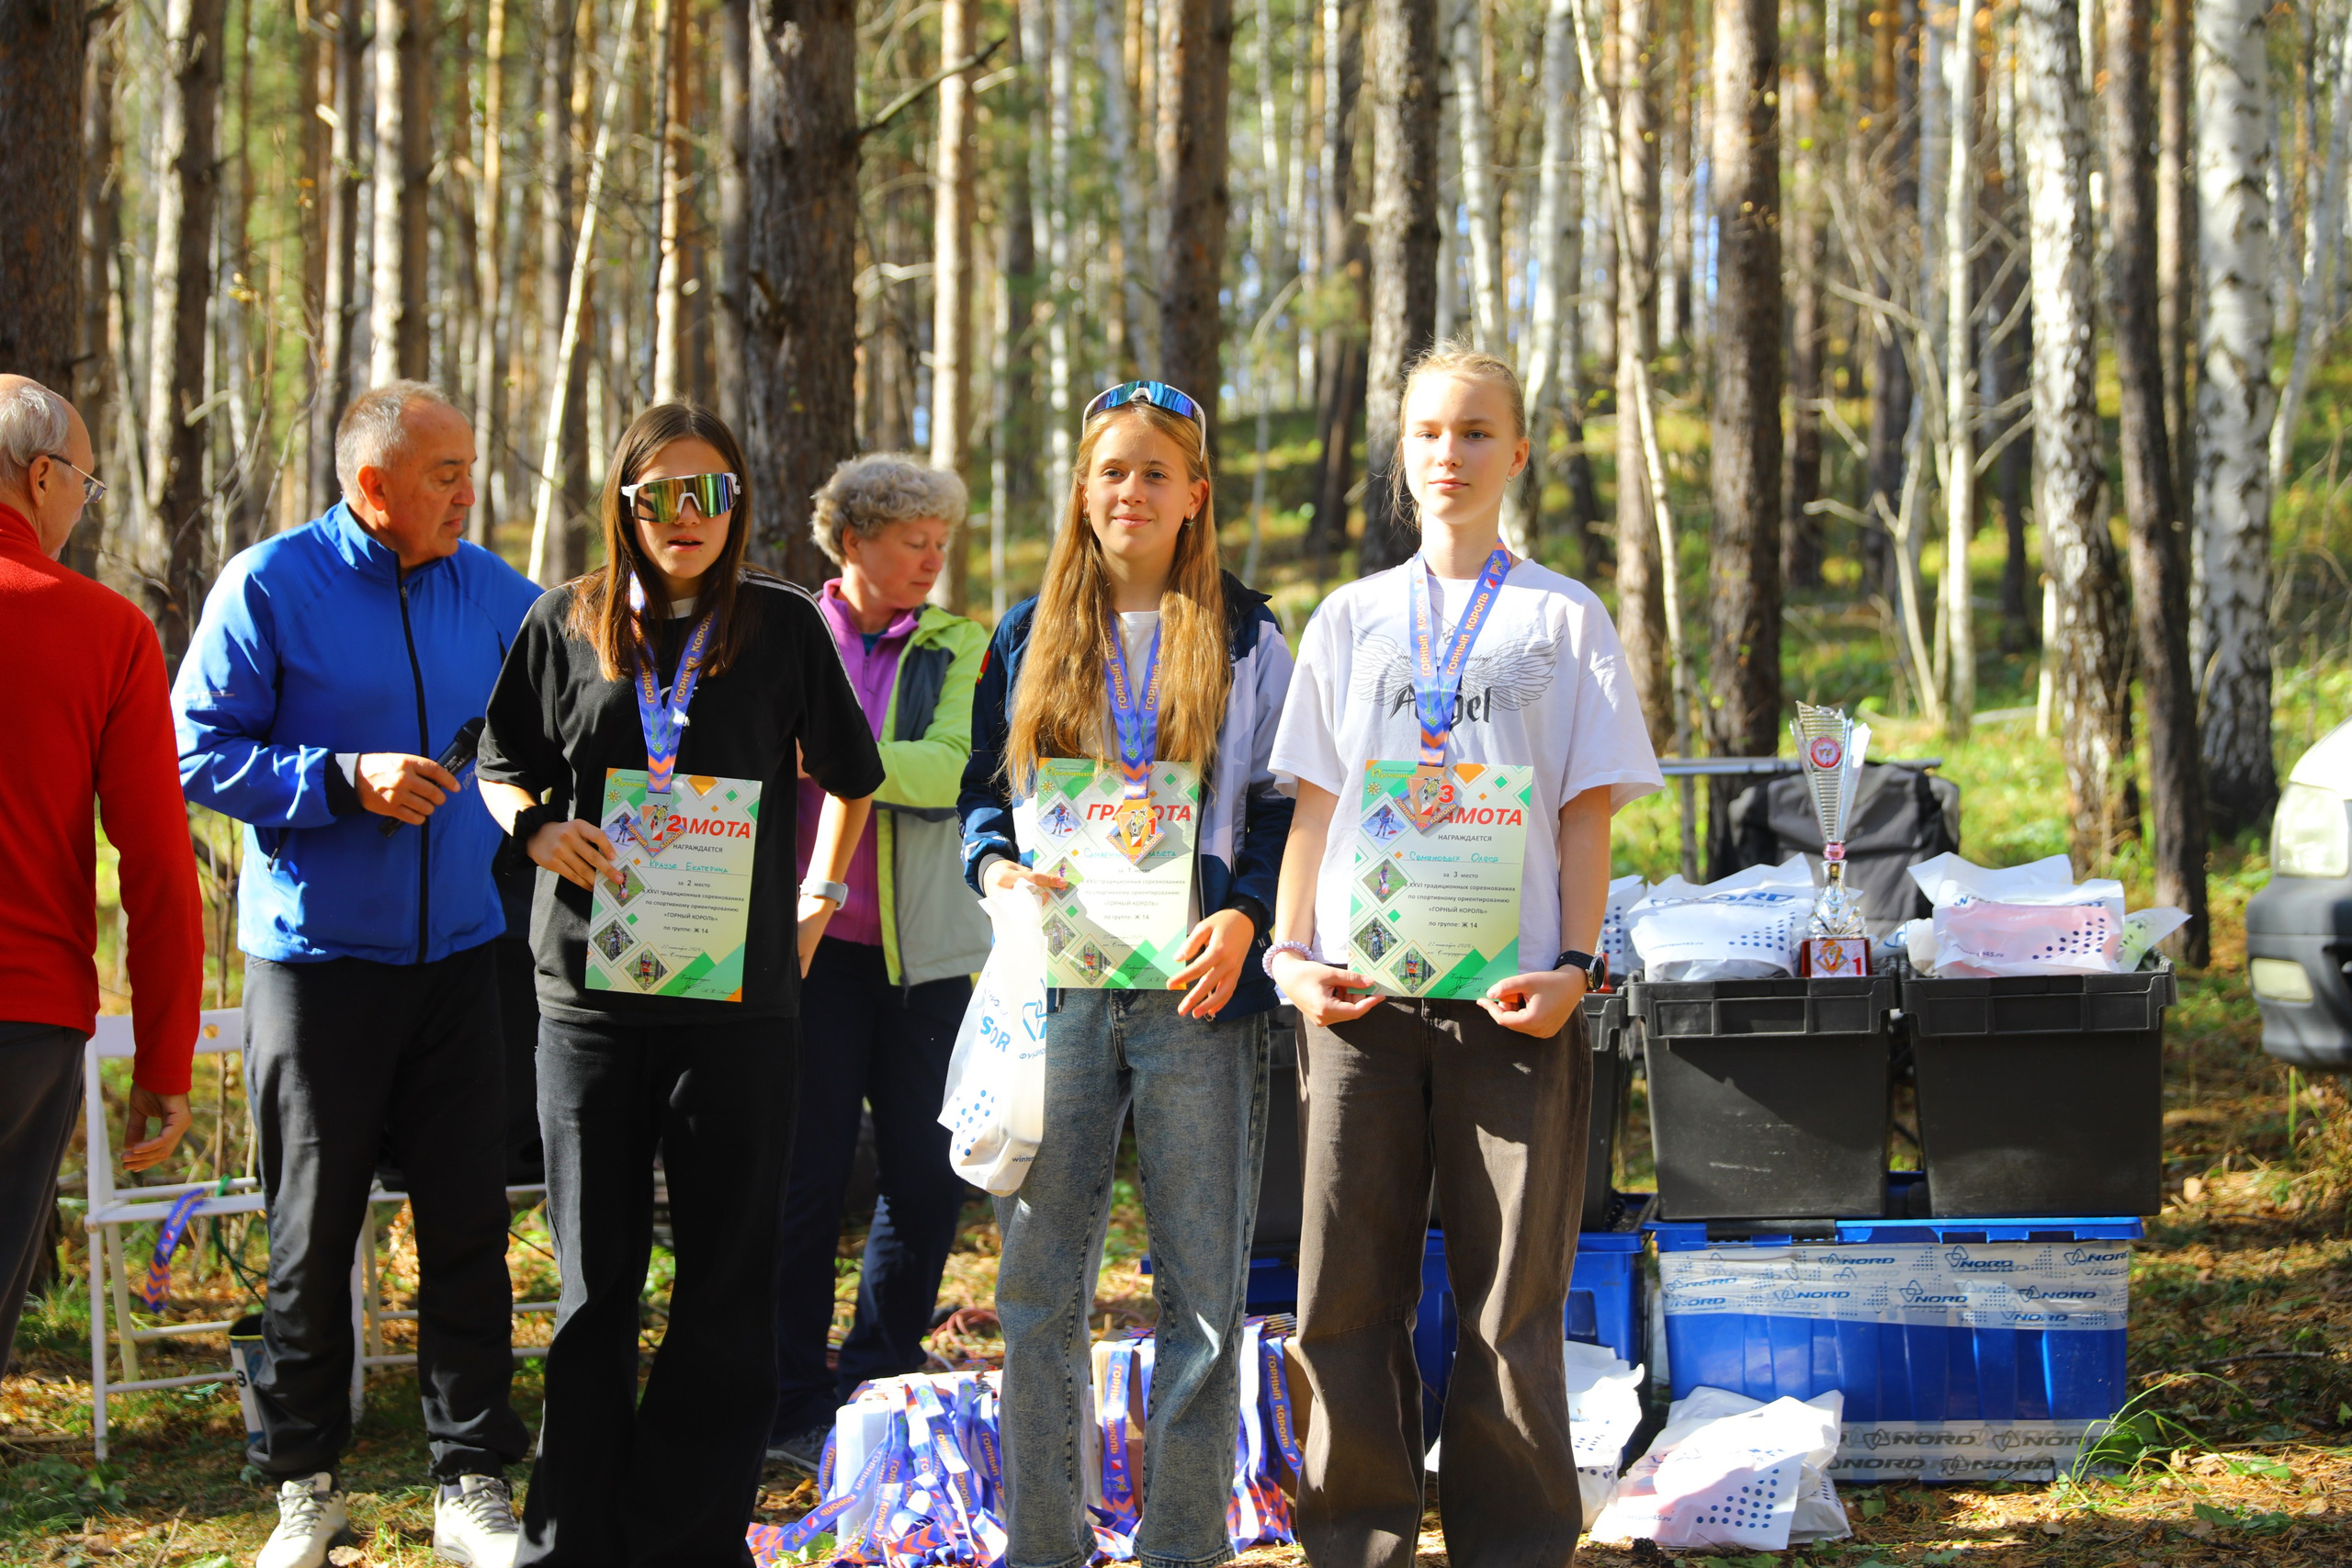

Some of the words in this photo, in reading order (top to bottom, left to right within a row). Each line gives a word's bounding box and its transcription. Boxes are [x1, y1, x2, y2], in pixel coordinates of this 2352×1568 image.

[1446, 634, 1470, 675] ГОРНЫЙ
[1464, 592, 1489, 630] КОРОЛЬ
[1419, 635, 1430, 676] ГОРНЫЙ
[1113, 664, 1128, 709] ГОРНЫЙ
[1389, 682, 1493, 732] Agel
[1438, 784, 1454, 804] 3
[1086, 804, 1191, 821] ГРОТА
[1430, 804, 1456, 824] КОРОЛЬ
[1439, 807, 1521, 826] АМОТА
[666, 814, 683, 833] 2
[683, 817, 751, 839] МОТА
[1148, 817, 1157, 835] 1
[627, 823, 649, 848] ГОРНЫЙ
[660, 829, 684, 850] КОРОЛЬ
[673, 843, 723, 853] НАГРАЖДАЕТСЯ
[660, 890, 701, 898] традиционных
[702, 894, 745, 902] соревнованиях
[1424, 883, 1468, 891] традиционных
[653, 901, 690, 909] спортивному
[691, 904, 739, 912] ориентированию
[1853, 957, 1861, 975] 1
[1960, 1259, 2012, 1268] NORD
[2087, 1252, 2129, 1262] NOR
[1683, 1278, 1737, 1288] NORD
[1674, 1297, 1726, 1307] NORD
[1915, 1295, 1968, 1303] NORD
[1267, 1355, 1283, 1401] ГОРНЫЙ
[1275, 1404, 1289, 1448] КОРОЛЬ
[1893, 1434, 1976, 1445] NORD
[981, 1432, 1000, 1476] ГОРНЫЙ
[854, 1450, 881, 1490] ГОРНЫЙ
[1842, 1459, 1926, 1469] NORD
[956, 1472, 971, 1507] ОРОЛЬ
[820, 1494, 856, 1516] КОРОЛЬ
